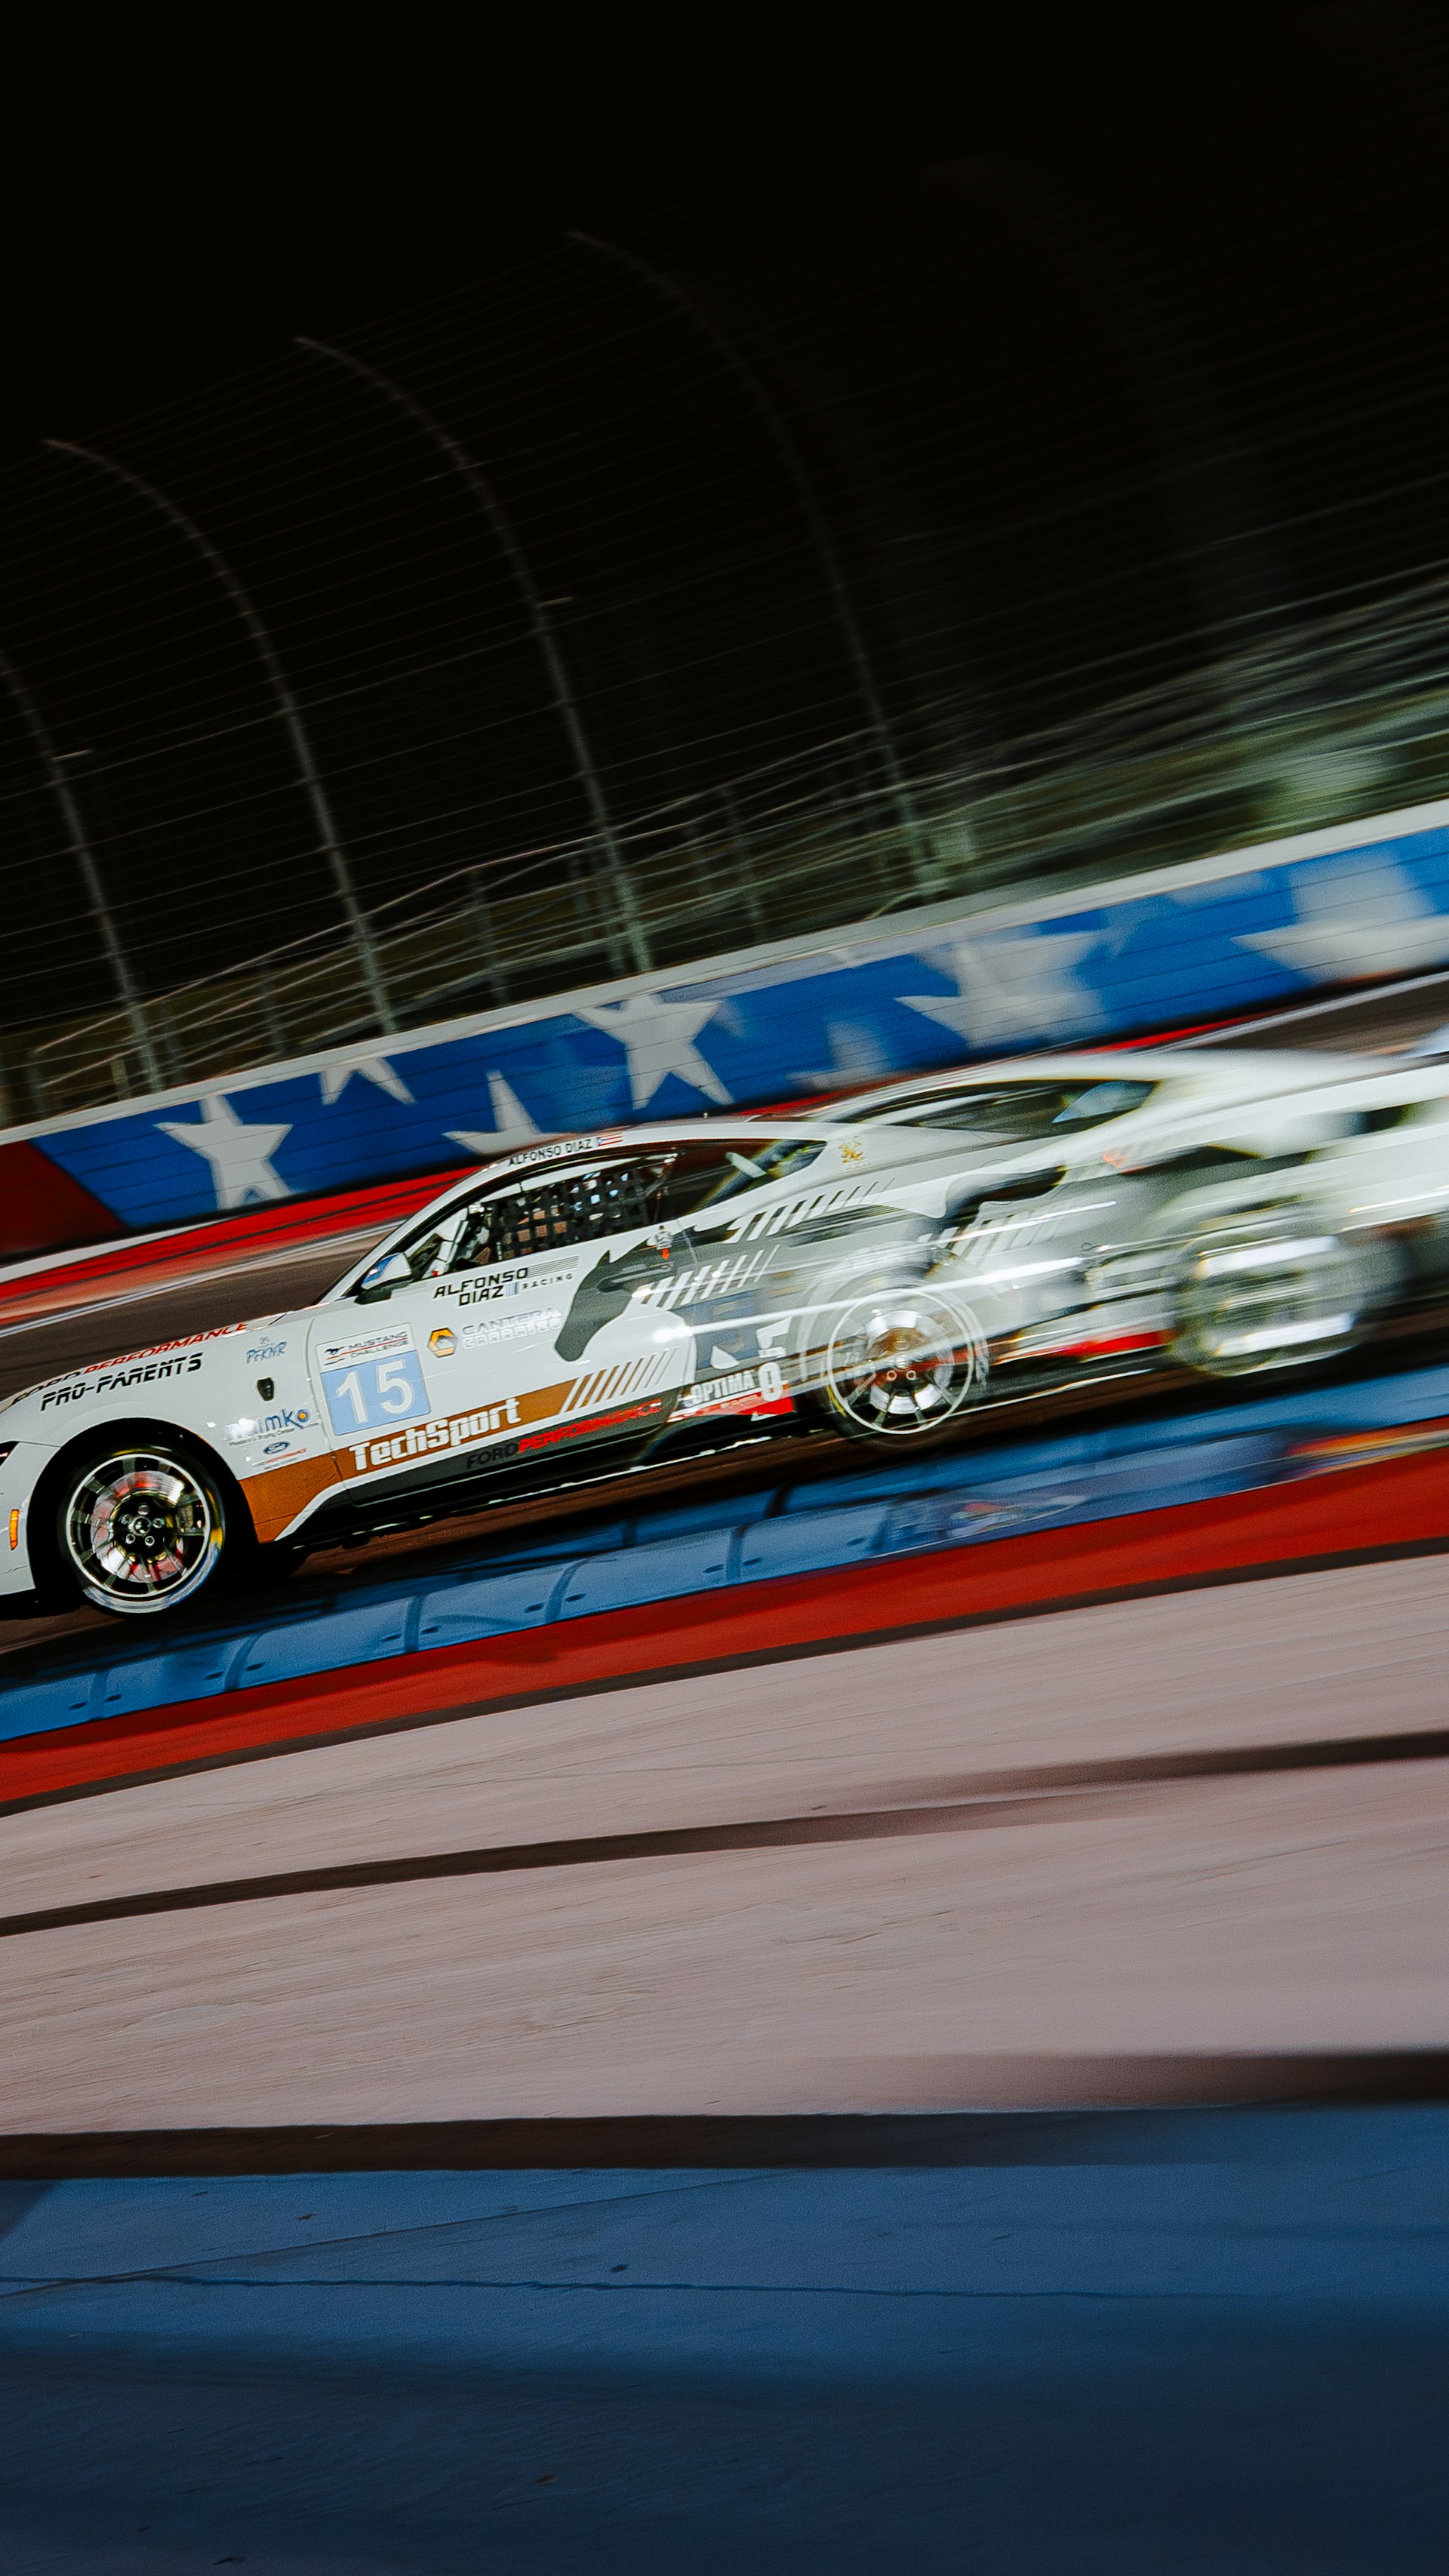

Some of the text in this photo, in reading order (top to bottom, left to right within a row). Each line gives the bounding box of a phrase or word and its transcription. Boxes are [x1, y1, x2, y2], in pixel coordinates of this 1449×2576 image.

[508, 1138, 594, 1167] ALFONSO DIAZ
[433, 1268, 529, 1299] ALFONSO
[459, 1274, 574, 1306] DIAZ RACING
[348, 1331, 408, 1349] MUSTANG
[349, 1340, 409, 1358] CHALLENGE
[41, 1353, 204, 1411] PRO-PARENTS
[336, 1359, 414, 1424] 15
[688, 1368, 755, 1406] OPTIMA
[349, 1397, 521, 1471] TechSport
